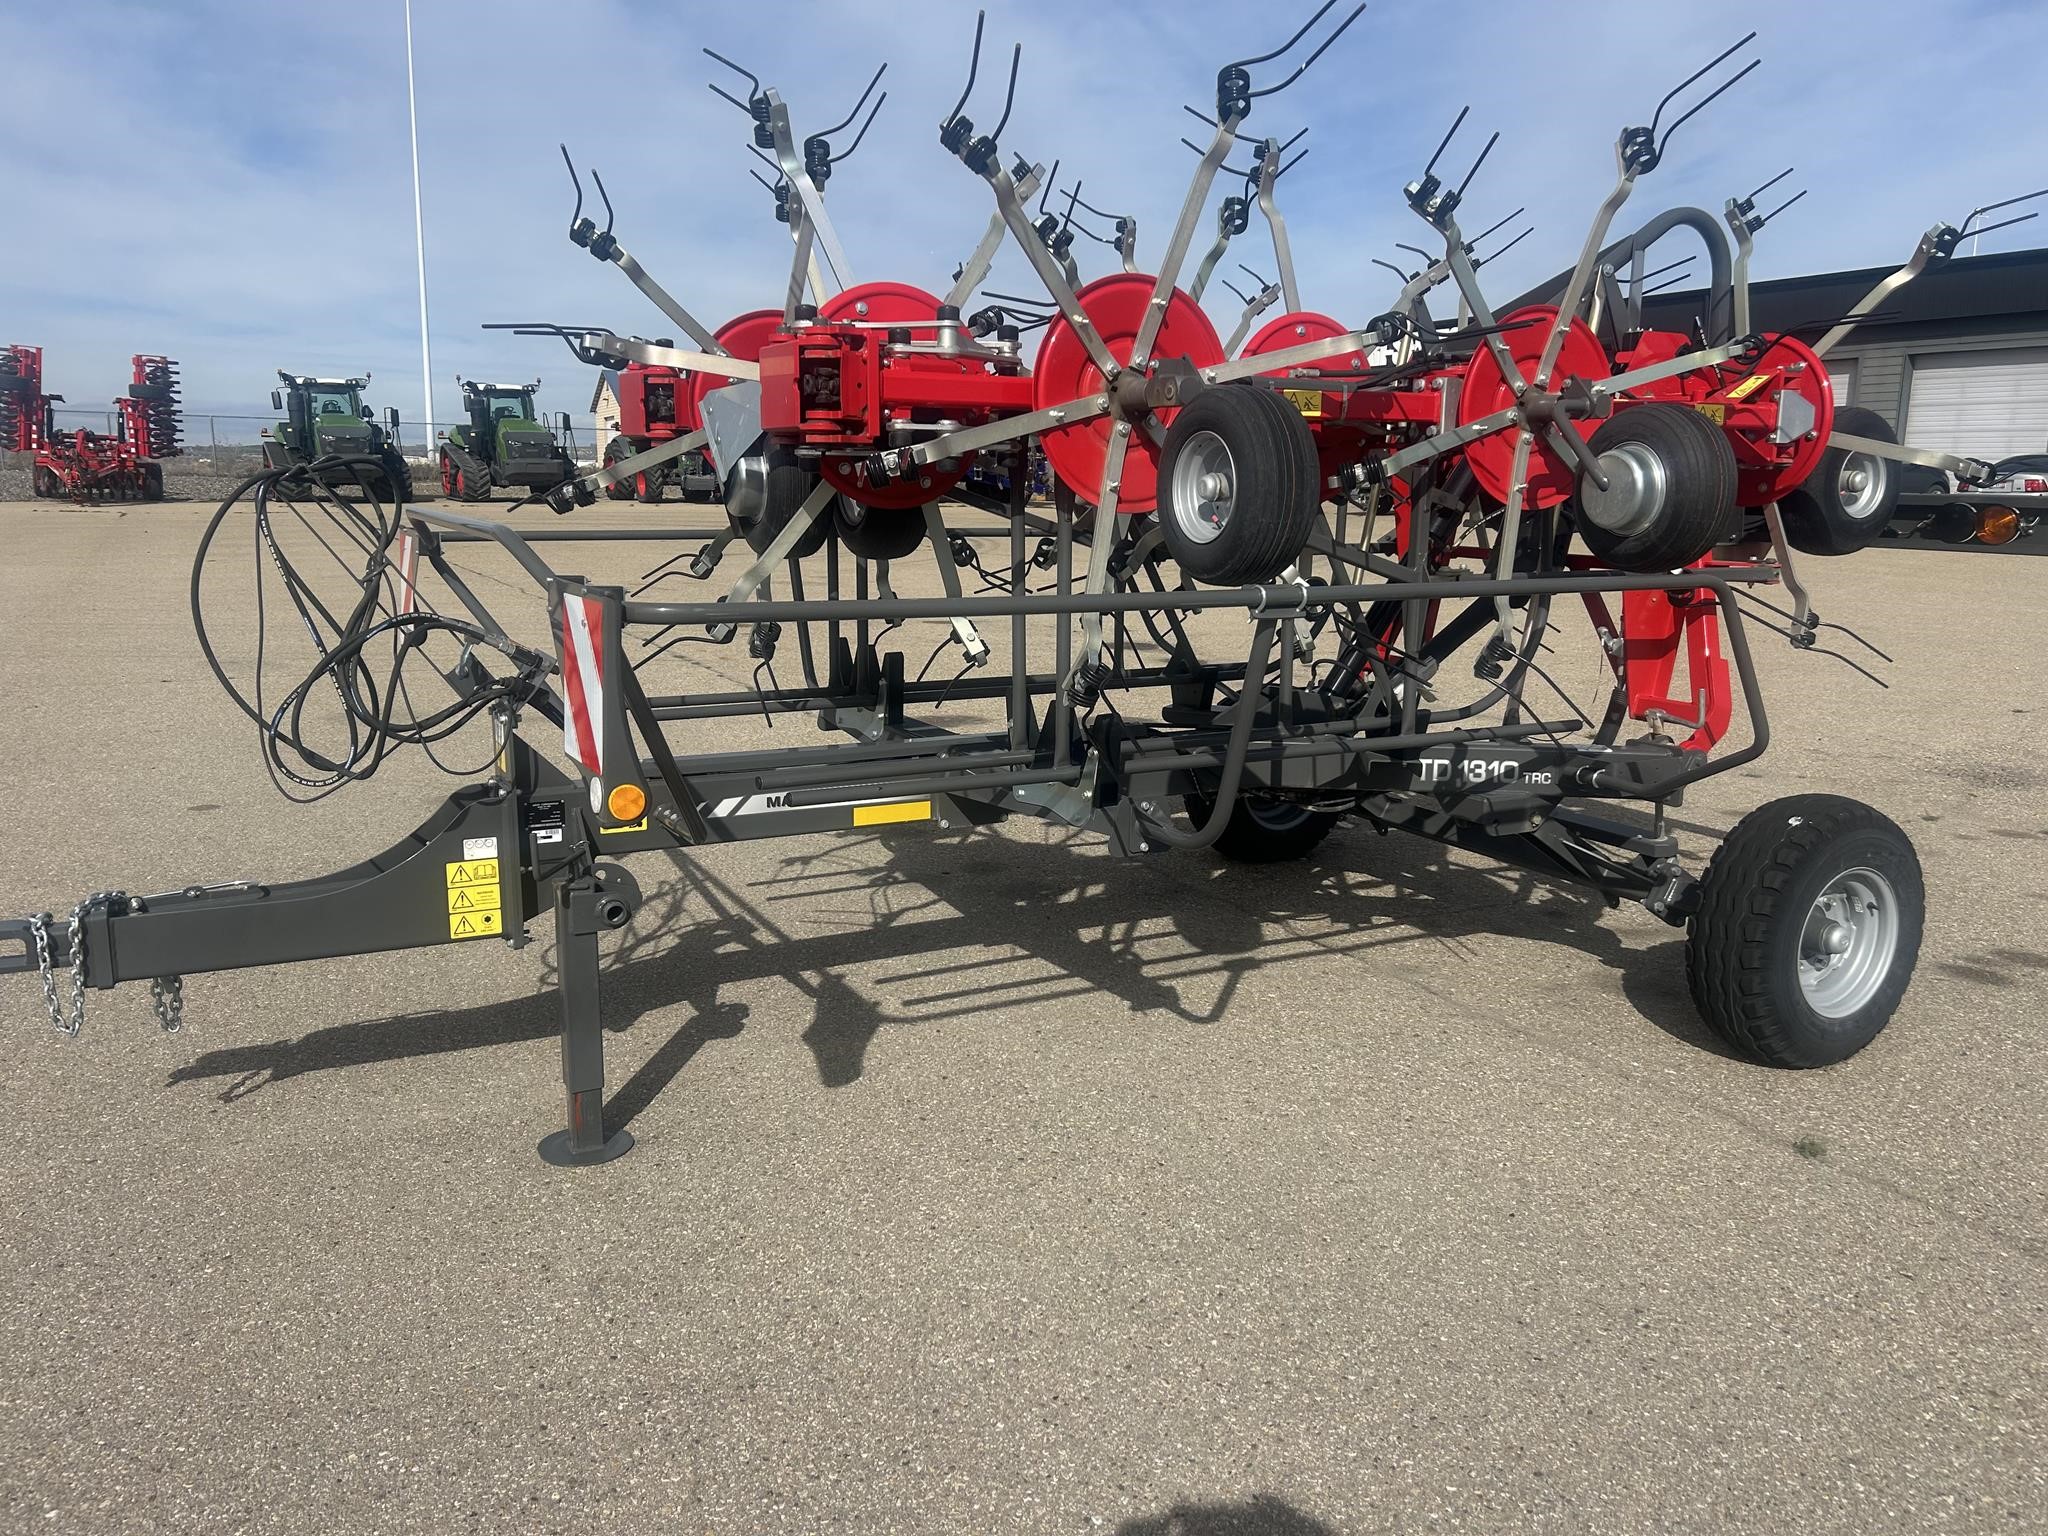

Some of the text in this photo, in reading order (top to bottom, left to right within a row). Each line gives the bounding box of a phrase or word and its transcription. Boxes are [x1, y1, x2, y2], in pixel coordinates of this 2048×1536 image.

[1418, 758, 1552, 785] TD 1310 TRC
